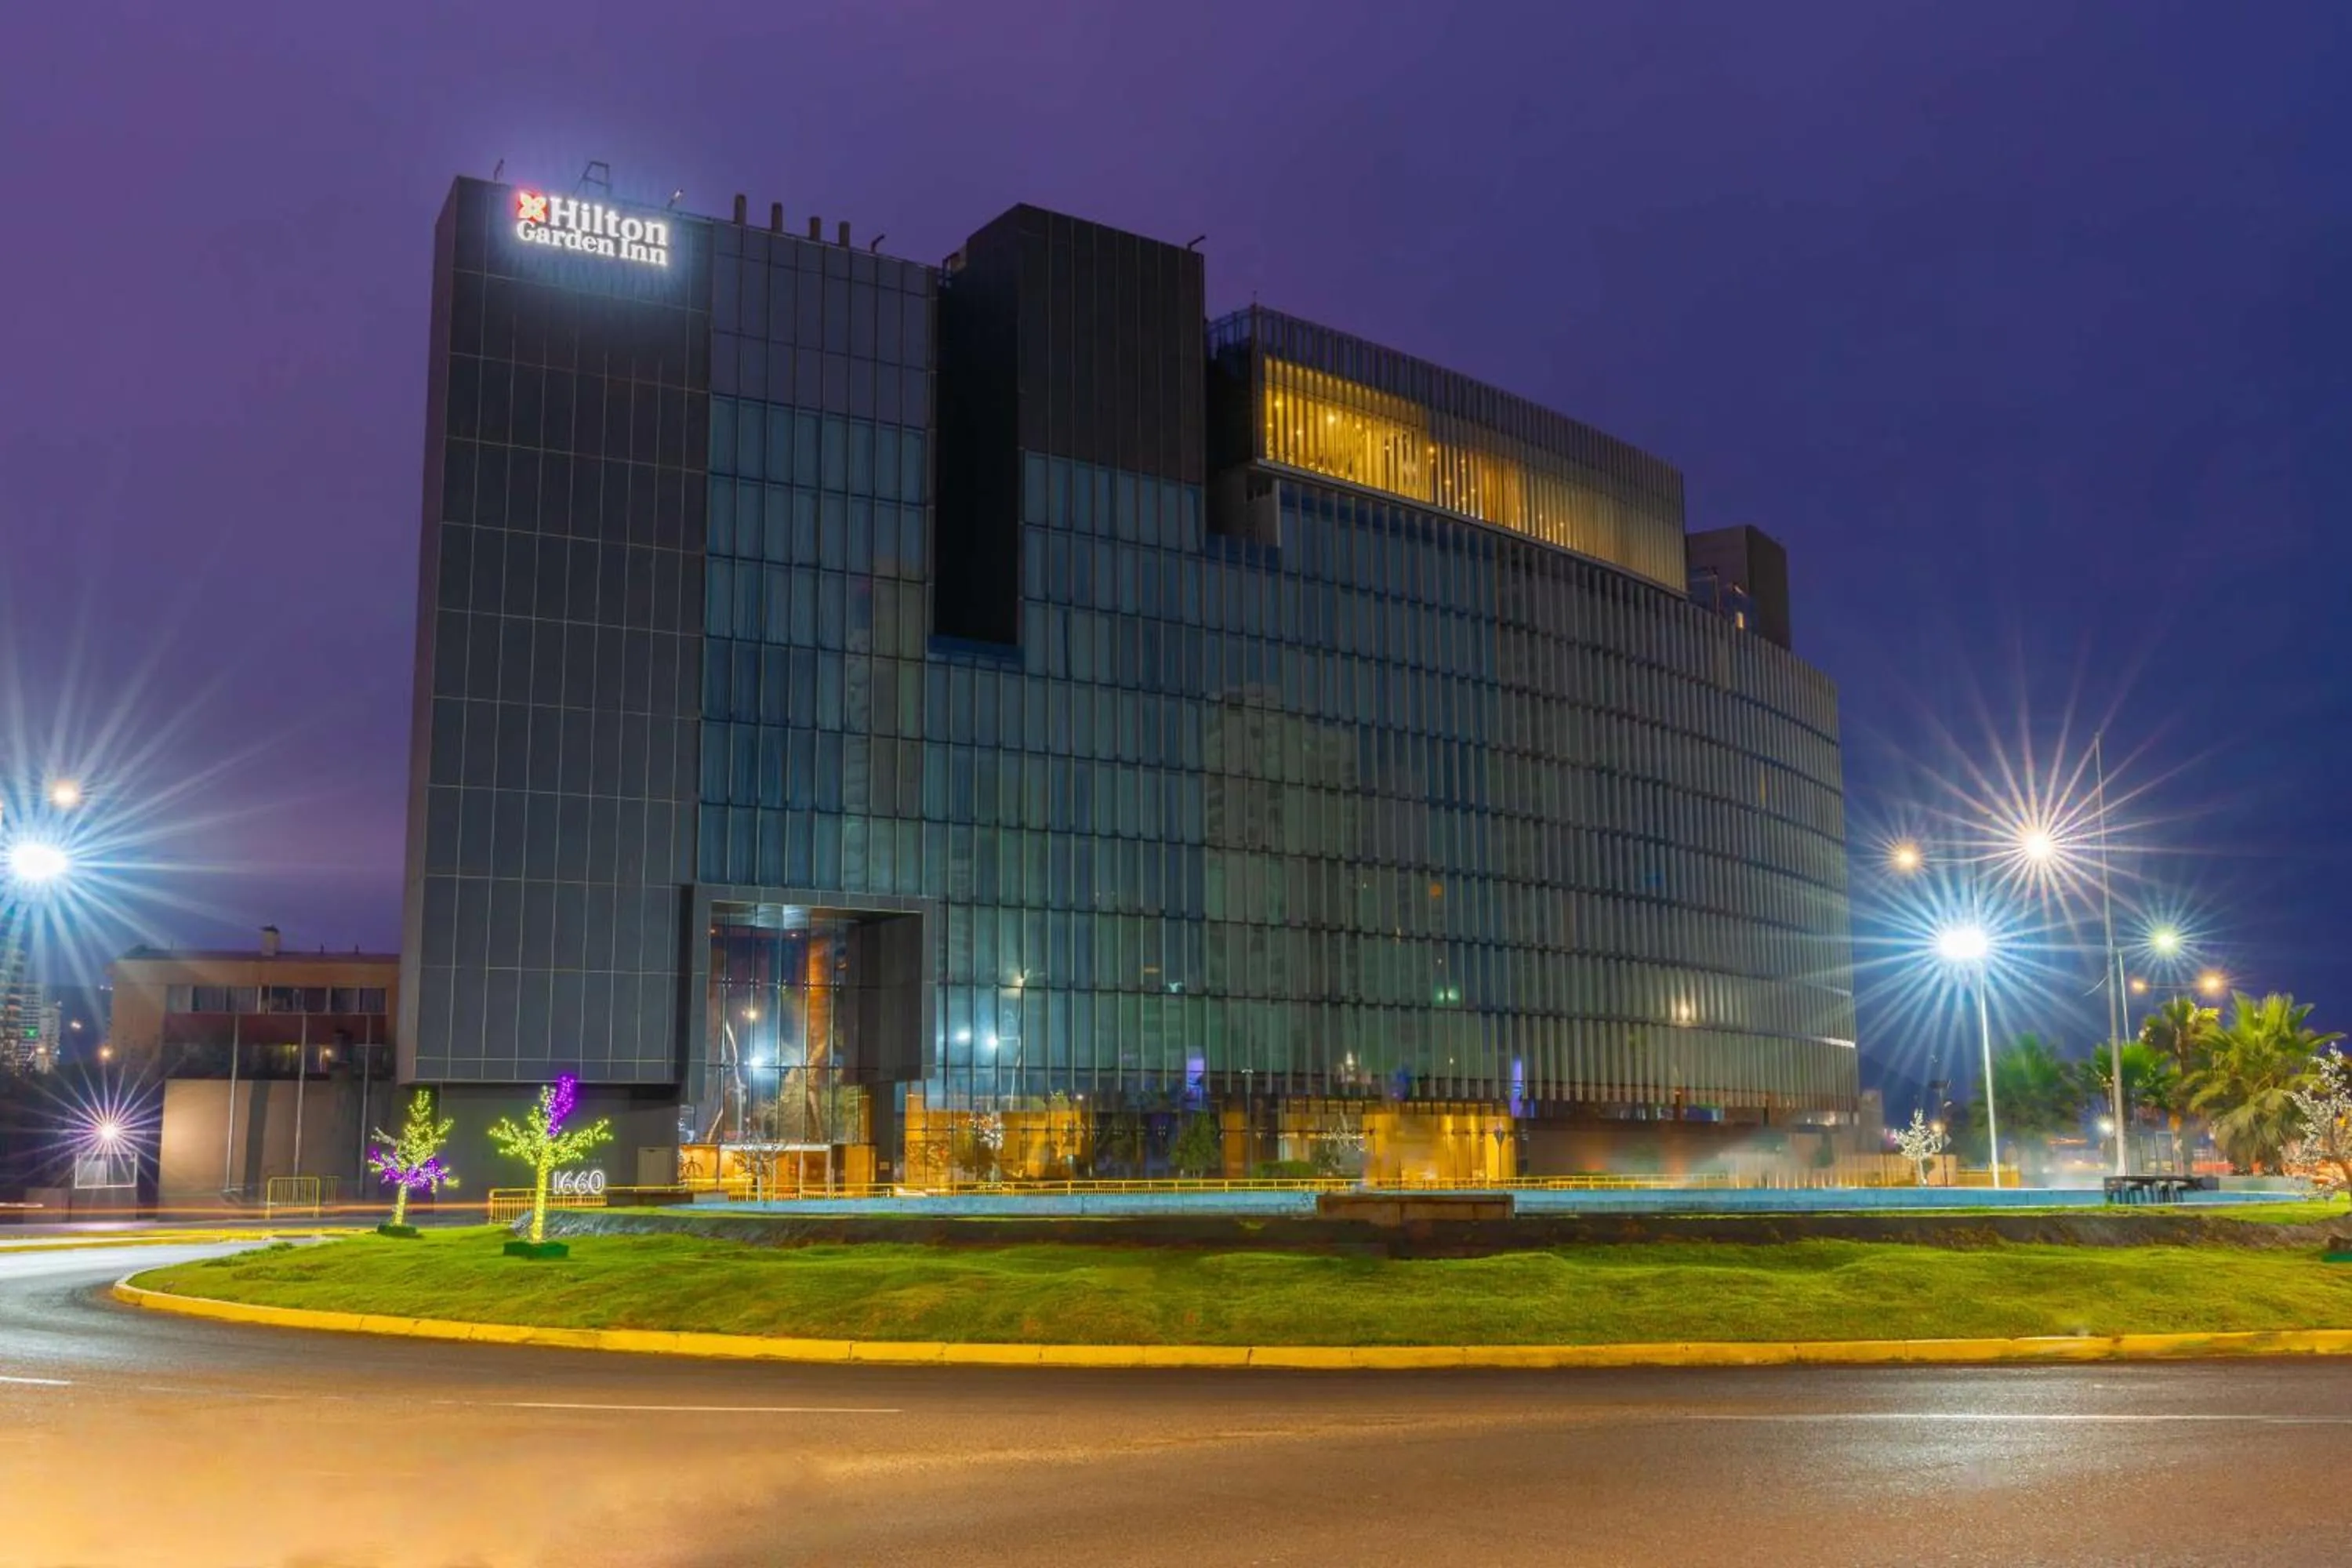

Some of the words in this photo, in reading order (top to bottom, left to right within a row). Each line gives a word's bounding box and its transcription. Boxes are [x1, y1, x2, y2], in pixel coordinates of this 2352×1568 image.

[517, 220, 615, 257] Garden
[619, 237, 667, 266] Inn
[550, 196, 667, 246] Hilton
[553, 1169, 604, 1195] 1660
